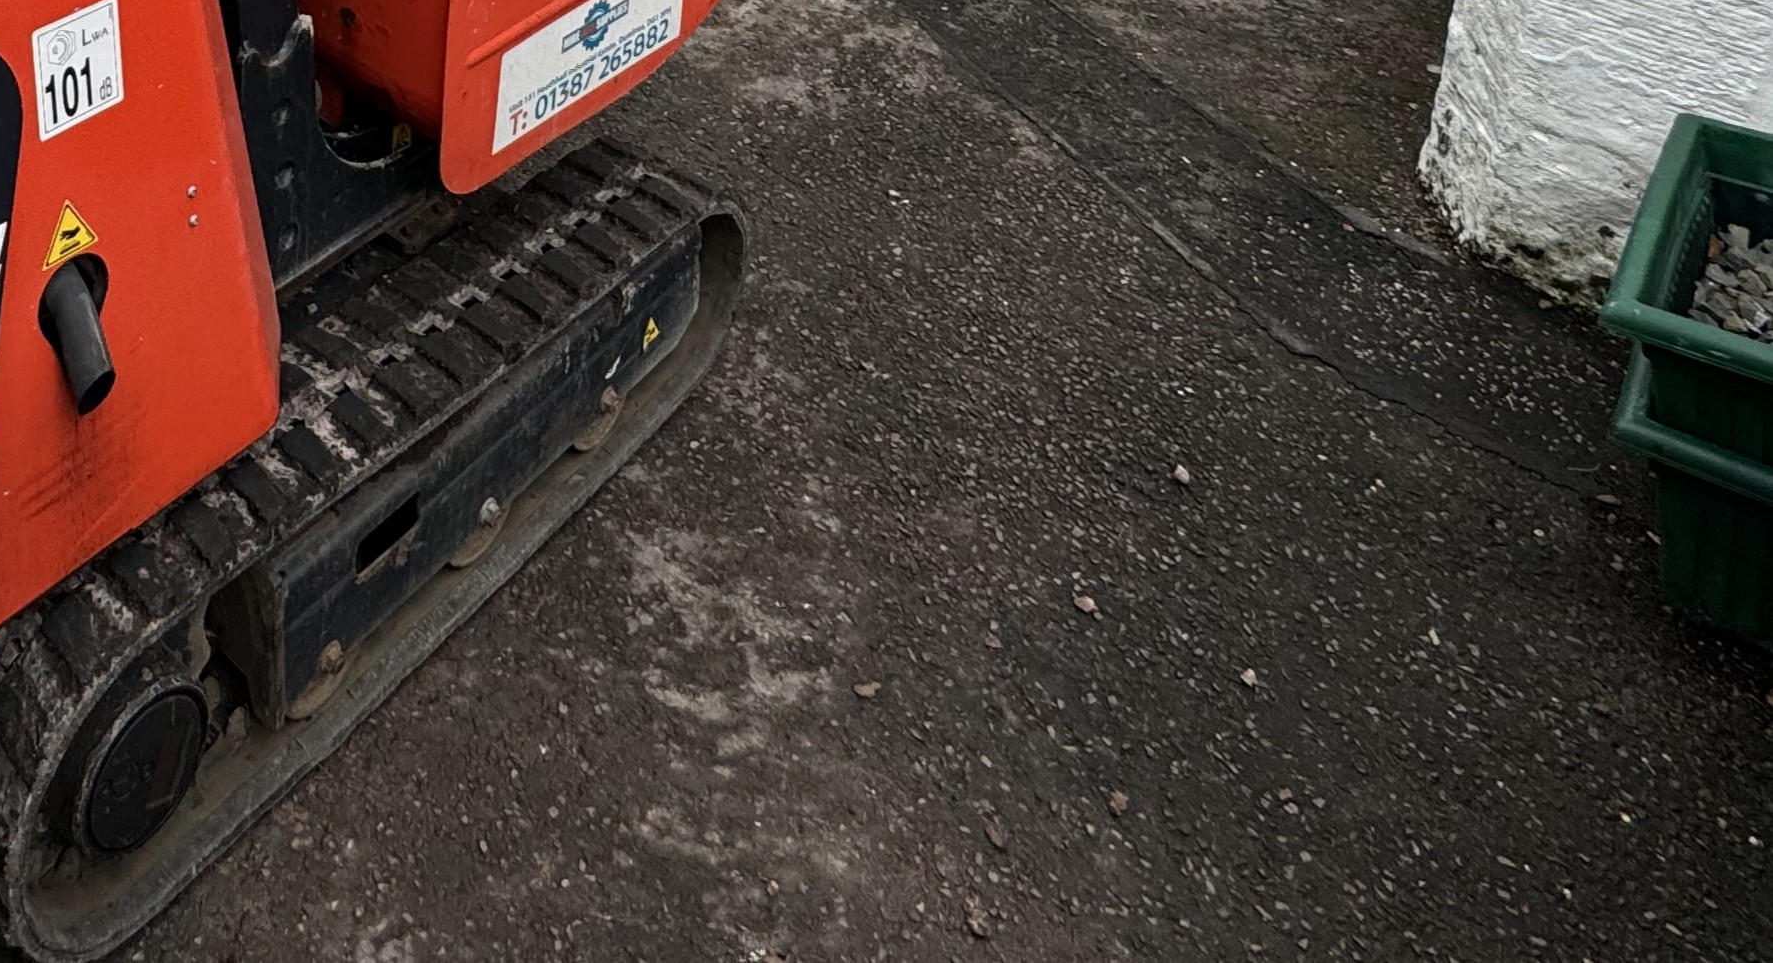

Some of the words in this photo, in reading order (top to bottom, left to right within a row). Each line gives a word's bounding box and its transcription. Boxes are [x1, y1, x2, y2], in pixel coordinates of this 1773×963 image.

[45, 57, 93, 124] 101
[99, 76, 113, 100] dB
[509, 110, 528, 135] T:
[534, 63, 595, 120] 01387
[598, 19, 669, 80] 265882
